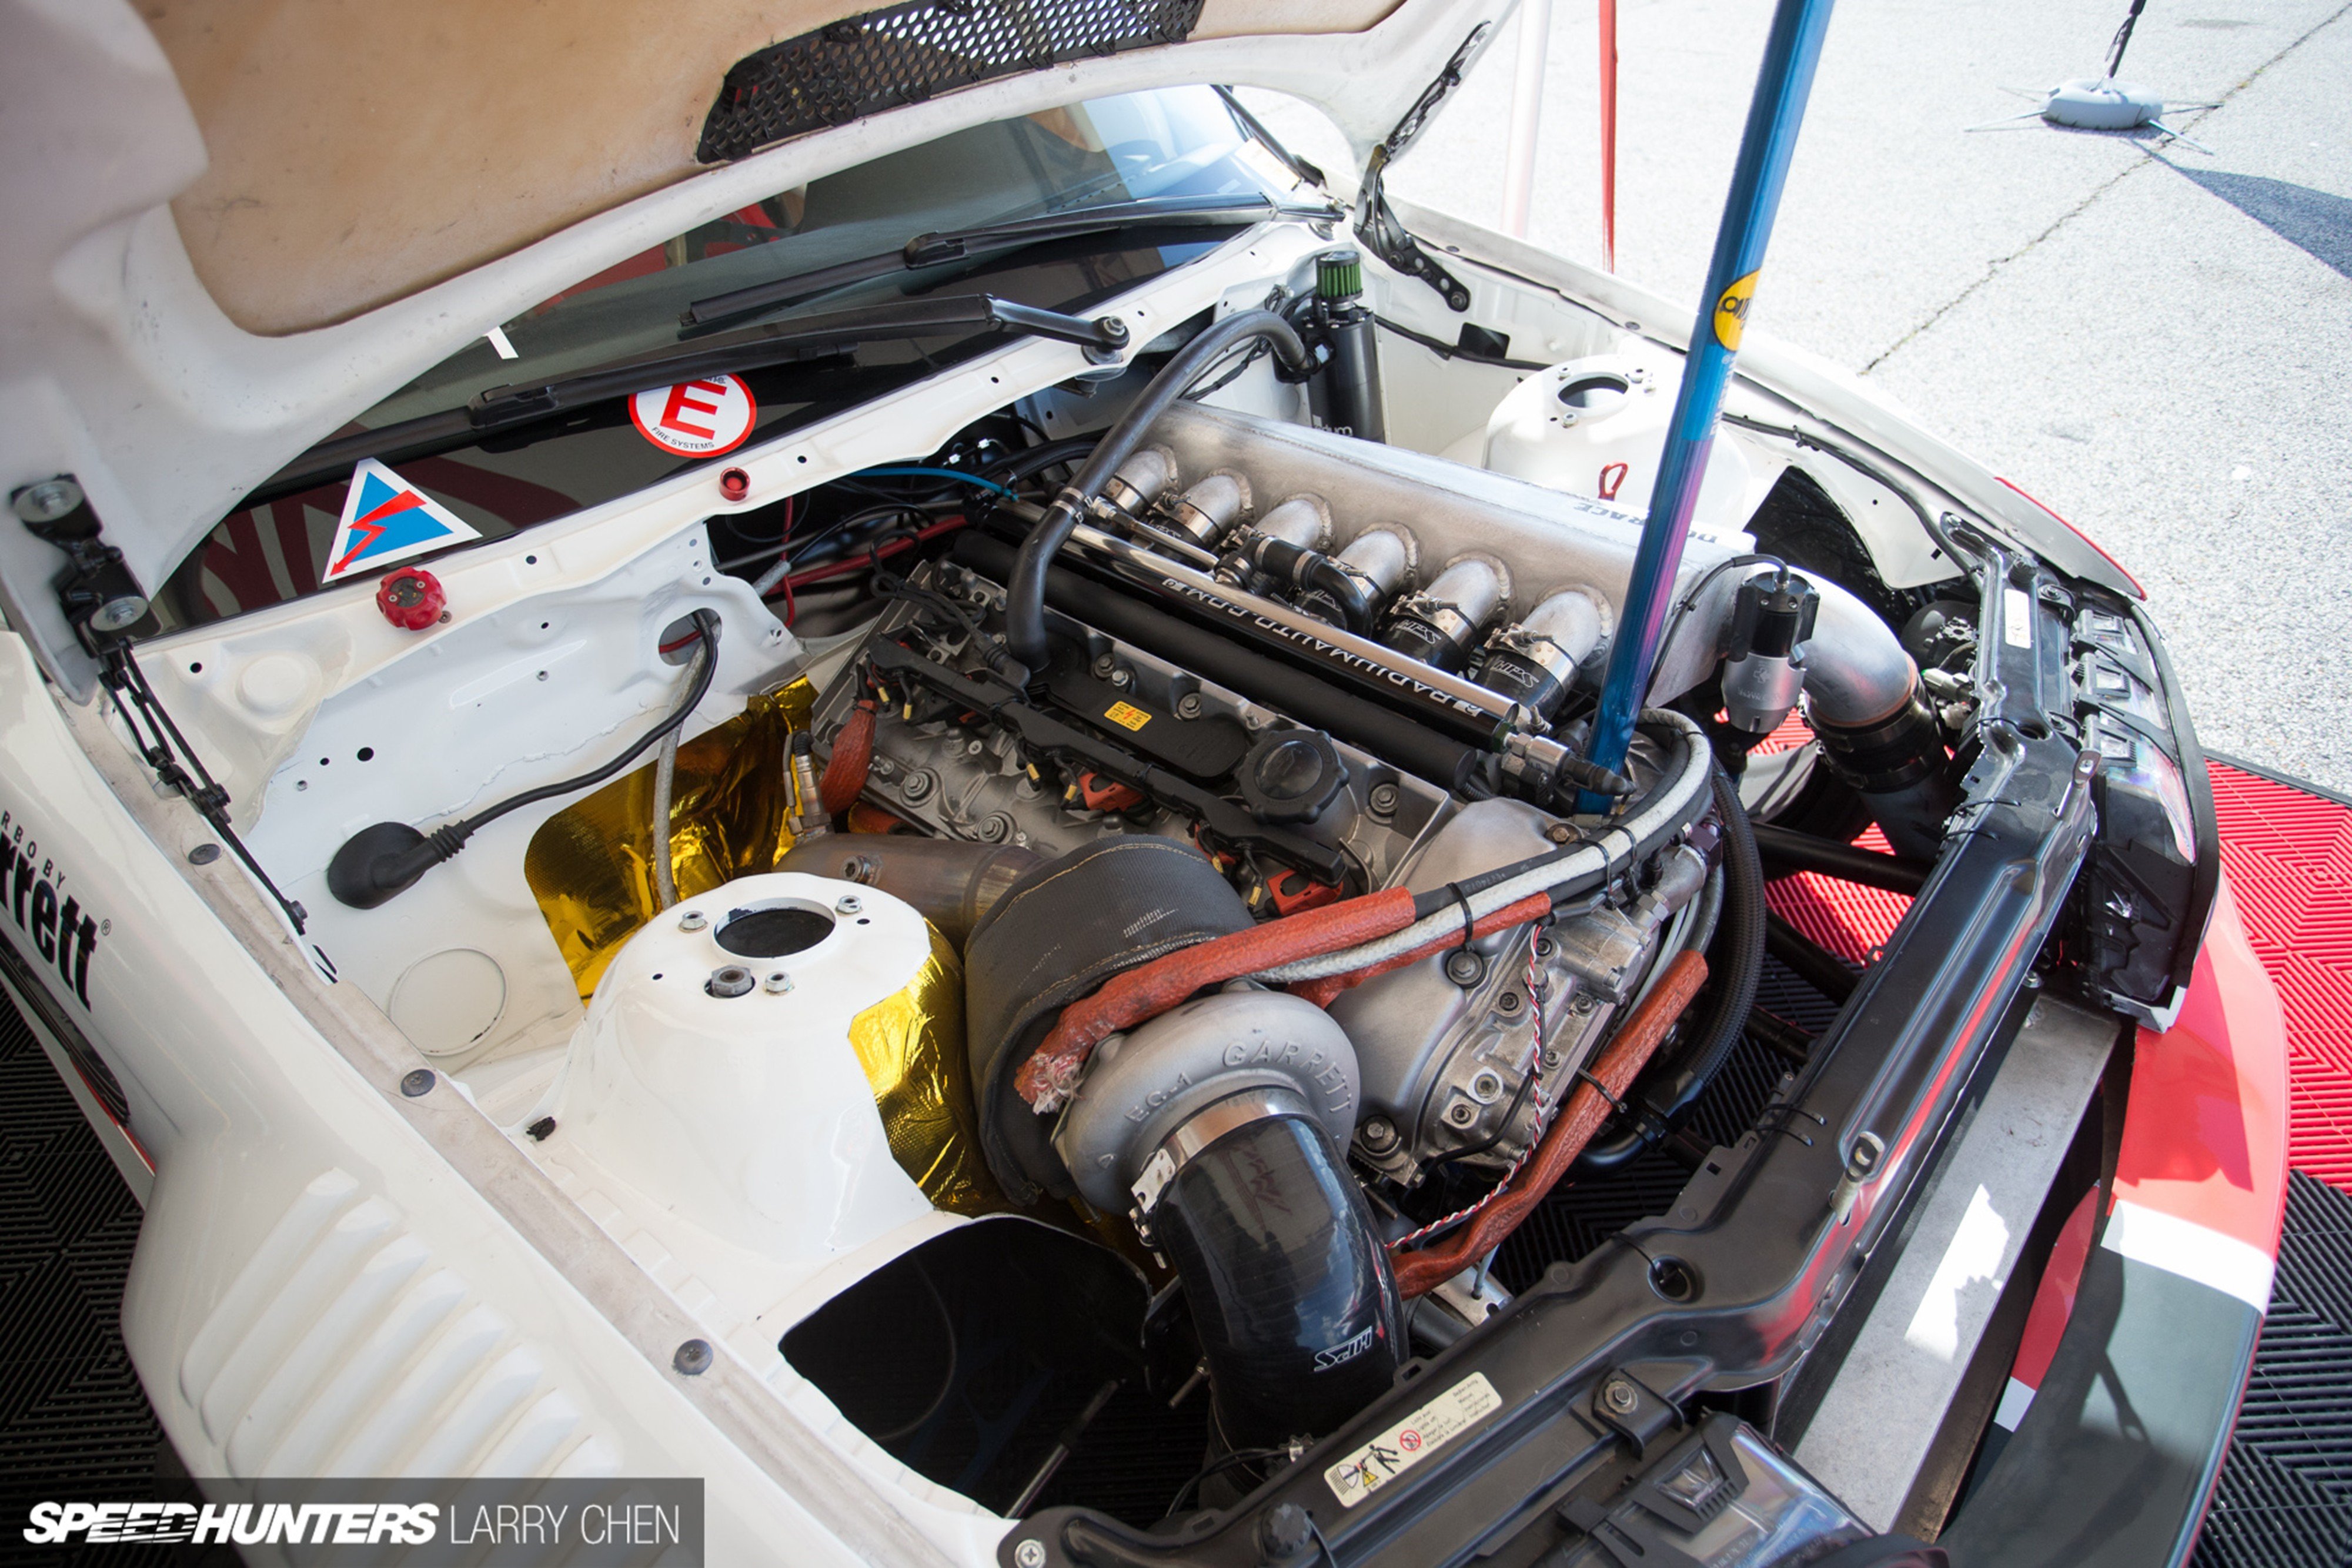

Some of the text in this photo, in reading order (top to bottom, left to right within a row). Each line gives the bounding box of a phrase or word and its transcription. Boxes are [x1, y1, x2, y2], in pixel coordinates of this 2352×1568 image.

[652, 426, 715, 450] FIRE SYSTEMS
[1186, 589, 1448, 705] RADIUMAUTO.COM
[1395, 619, 1442, 644] HPS
[1489, 659, 1540, 688] HPS
[43, 858, 66, 890] BY
[1222, 1039, 1351, 1116] GARRETT
[1314, 1325, 1373, 1372] HPS
